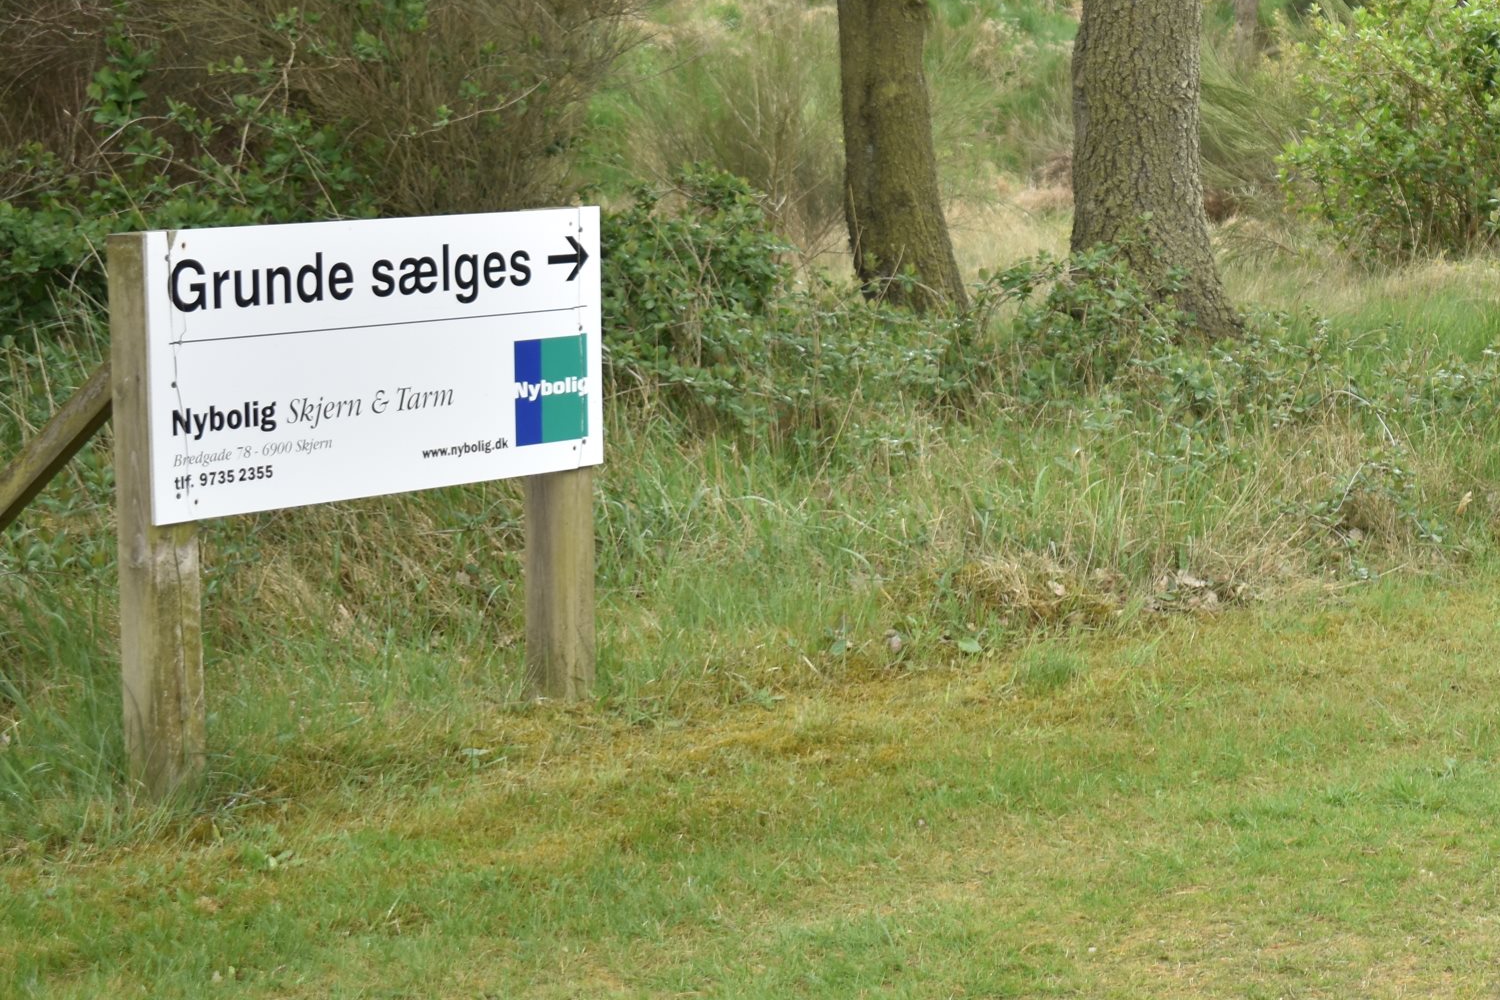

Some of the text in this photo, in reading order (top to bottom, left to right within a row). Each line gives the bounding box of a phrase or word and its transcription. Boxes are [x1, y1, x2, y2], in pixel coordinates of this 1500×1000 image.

[168, 244, 532, 313] Grunde sælges
[514, 376, 589, 401] Nybolig
[172, 386, 455, 441] Nybolig Skjern & Tarm
[173, 449, 232, 468] Bredgade
[236, 445, 252, 460] 78
[262, 440, 293, 457] 6900
[295, 438, 333, 455] Skjern
[422, 437, 509, 458] www.nybolig.dk
[174, 465, 274, 490] tlf. 9735 2355
